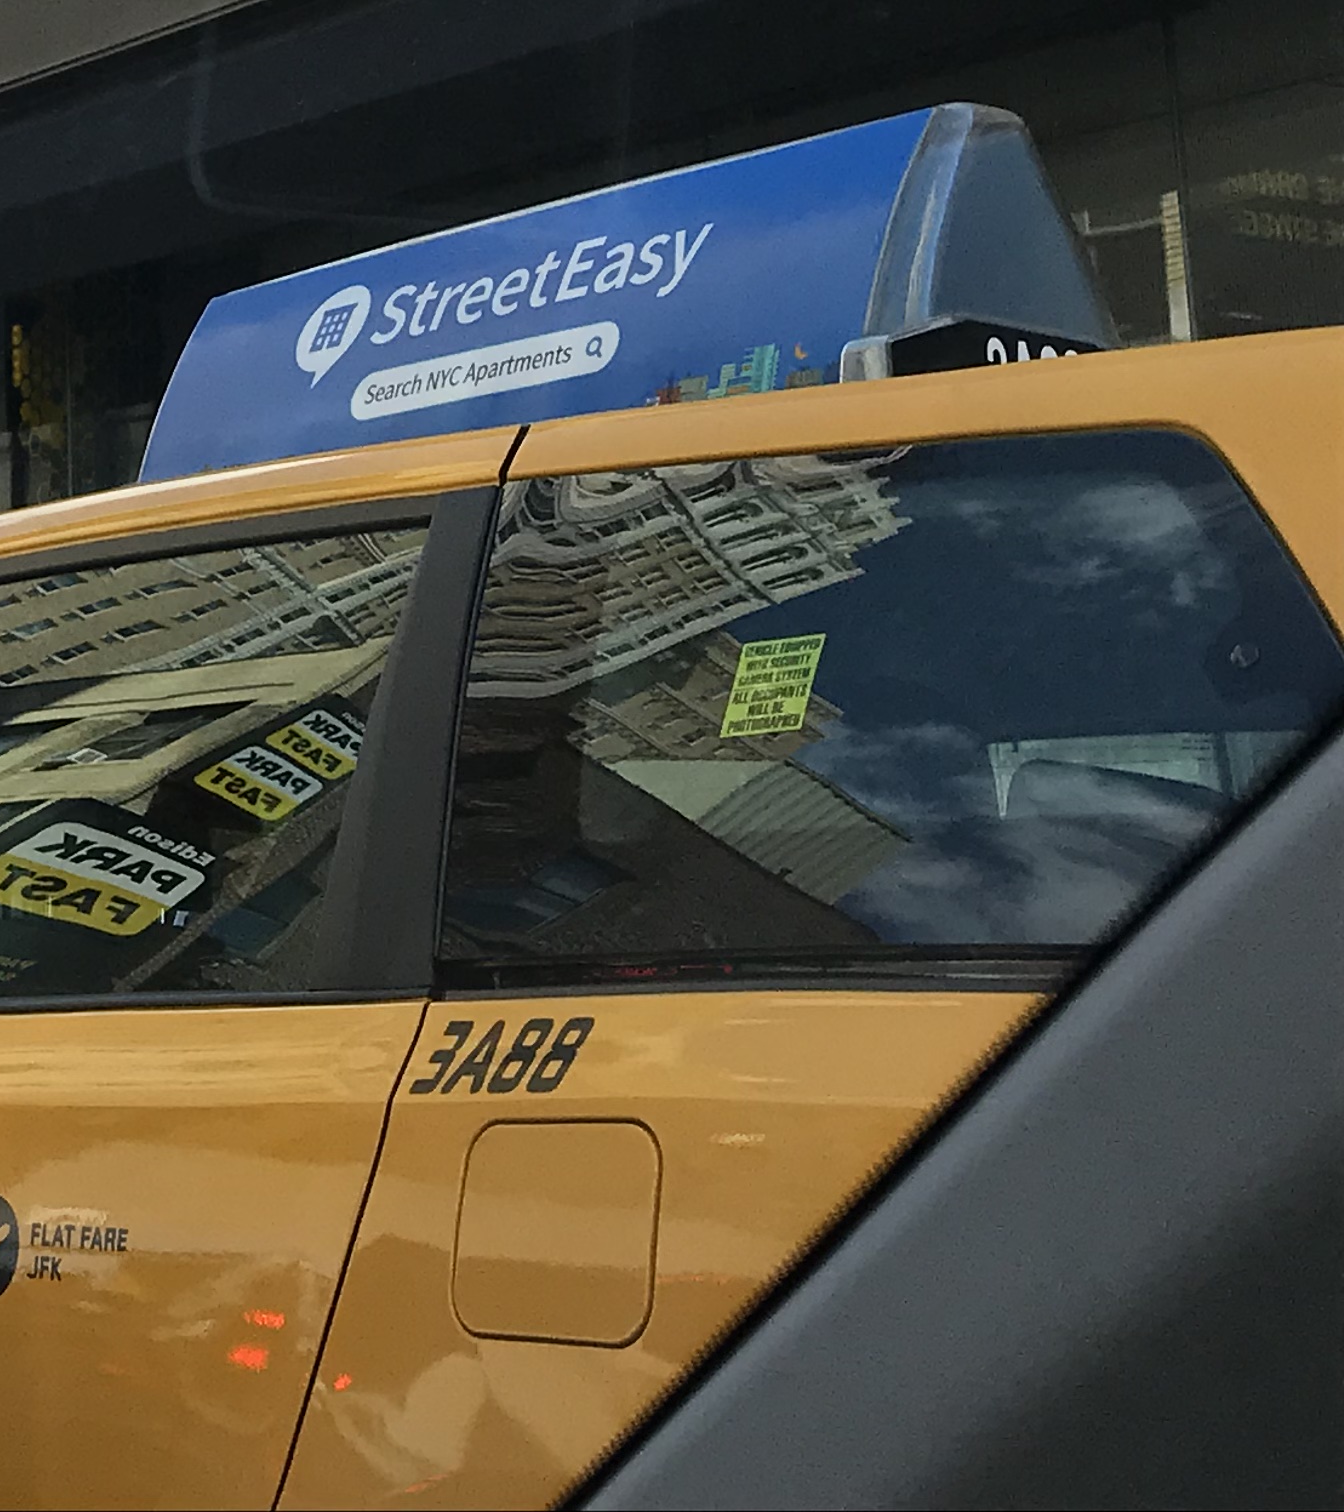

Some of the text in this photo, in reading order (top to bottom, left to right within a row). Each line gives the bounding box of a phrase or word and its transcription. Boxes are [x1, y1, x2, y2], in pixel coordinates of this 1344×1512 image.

[369, 221, 715, 346] StreetEasy
[364, 343, 573, 406] Search NYC Apartments
[732, 690, 749, 705] ALL
[409, 1016, 596, 1096] 3A88
[29, 1221, 130, 1254] FLAT FARE
[26, 1253, 63, 1283] JFK
